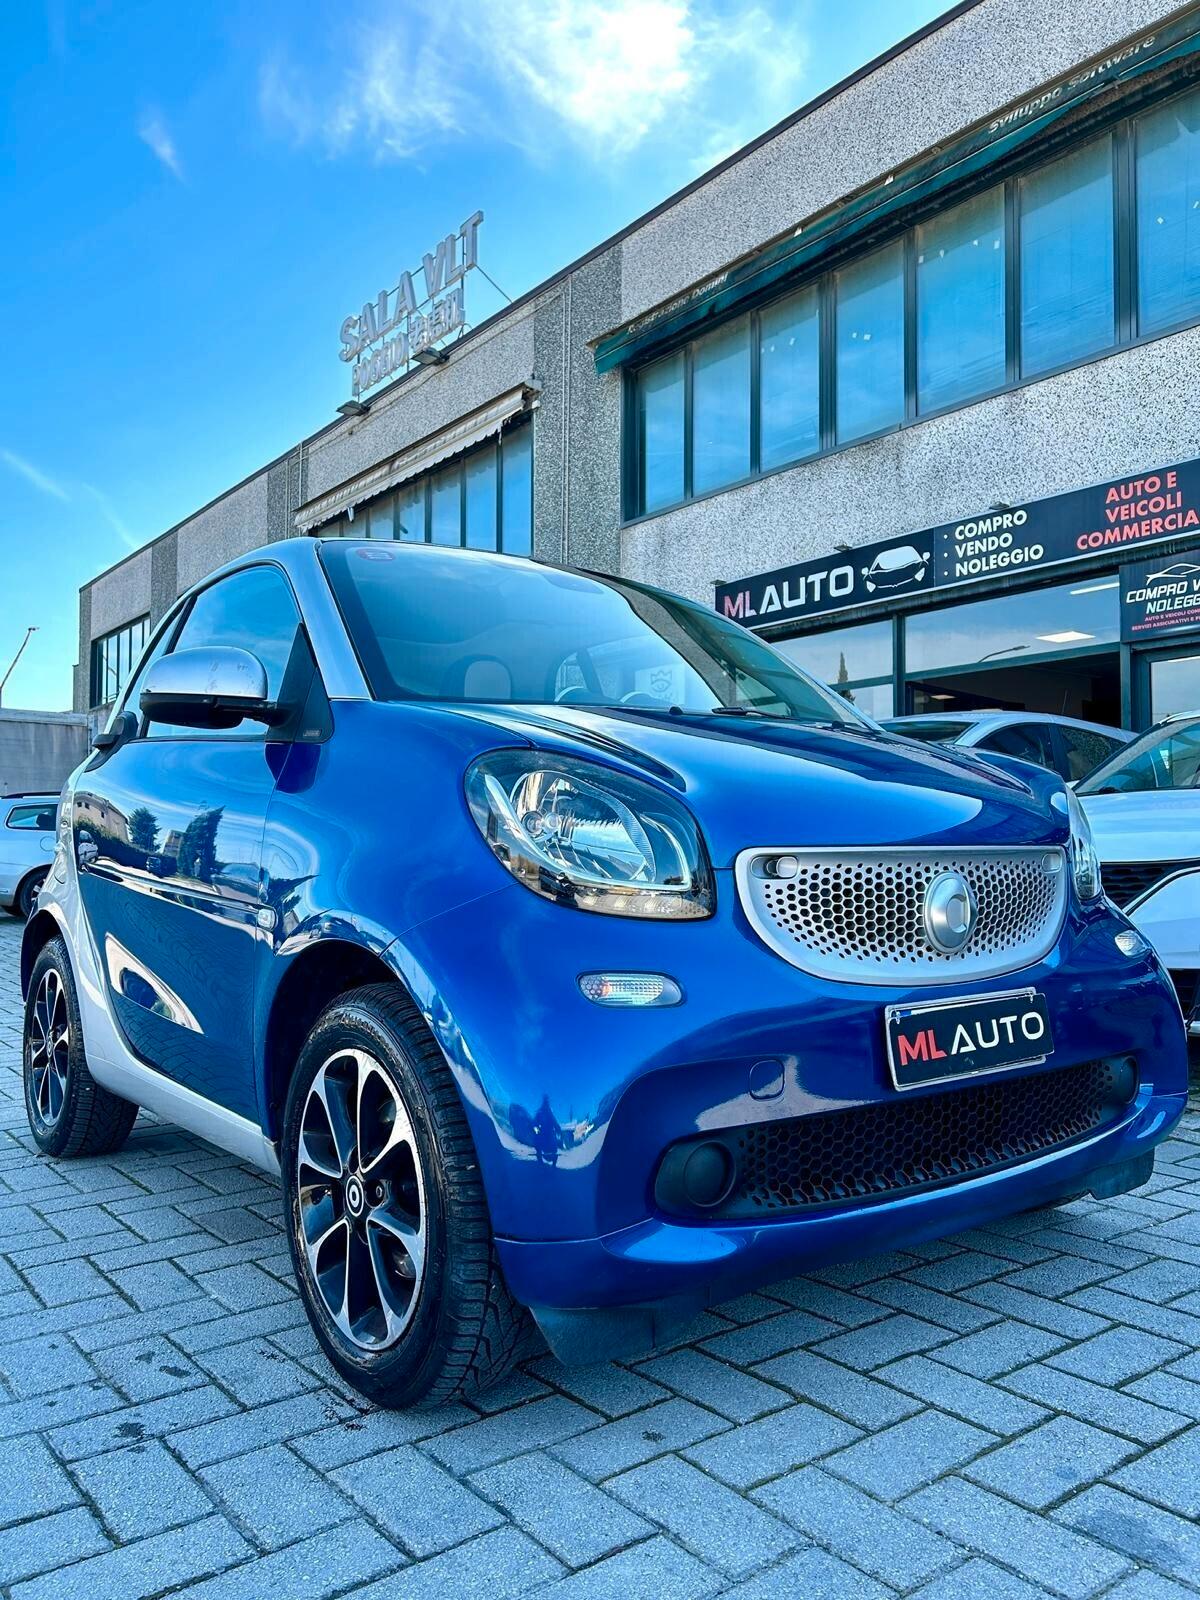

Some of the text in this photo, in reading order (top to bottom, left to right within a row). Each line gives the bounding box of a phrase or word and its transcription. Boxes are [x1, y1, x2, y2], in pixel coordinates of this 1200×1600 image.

[339, 271, 416, 362] SALA
[422, 210, 483, 298] VLT
[1105, 471, 1177, 504] AUTO E
[1105, 491, 1182, 523] VEICOLI
[954, 509, 1028, 540] COMPRO
[1076, 509, 1200, 550] COMMERCIA
[954, 532, 1013, 559] VENDO
[955, 544, 1044, 577] NOLEGGIO
[1126, 580, 1188, 604] COMPRO
[1145, 593, 1200, 615] NOLEGG
[1144, 614, 1160, 622] AUTO
